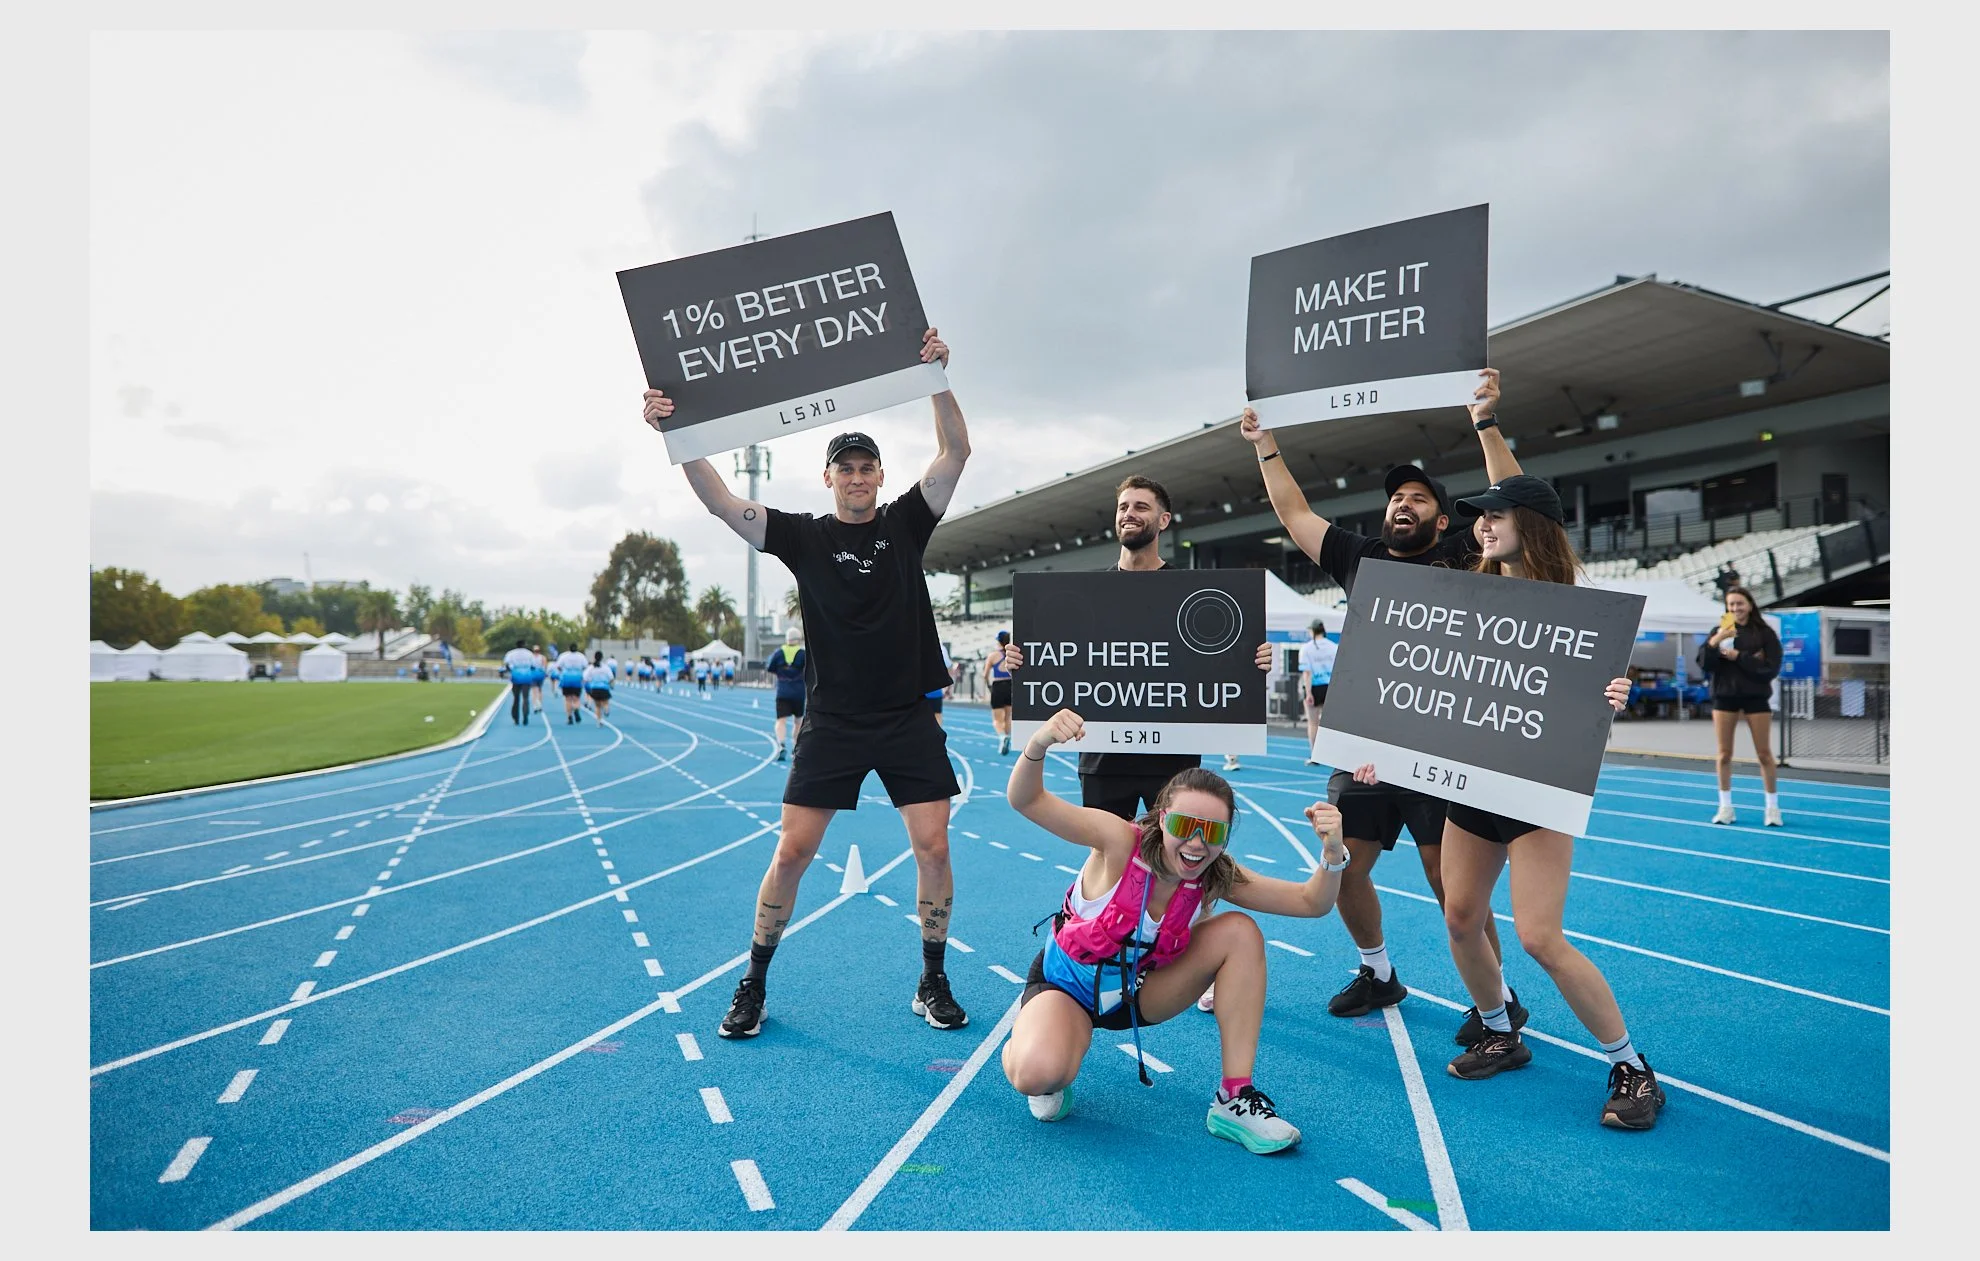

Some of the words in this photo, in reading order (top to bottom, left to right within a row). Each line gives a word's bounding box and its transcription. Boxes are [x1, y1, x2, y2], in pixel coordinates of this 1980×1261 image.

[662, 300, 725, 339] 1%
[734, 263, 886, 323] BETTER
[1294, 269, 1387, 315] MAKE
[1398, 261, 1429, 296] IT
[678, 324, 802, 382] EVERY
[814, 302, 889, 348] DAY
[1293, 305, 1426, 355] MATTER
[1023, 641, 1078, 667] TAP
[1088, 641, 1170, 667] HERE
[1370, 597, 1381, 622] I
[1384, 599, 1468, 637] HOPE
[1475, 612, 1599, 660] YOU’RE
[1022, 681, 1064, 707] TO
[1074, 682, 1187, 708] POWER
[1198, 682, 1242, 708] UP
[1388, 640, 1549, 696] COUNTING
[1377, 677, 1457, 720] YOUR
[1462, 696, 1544, 740] LAPS
